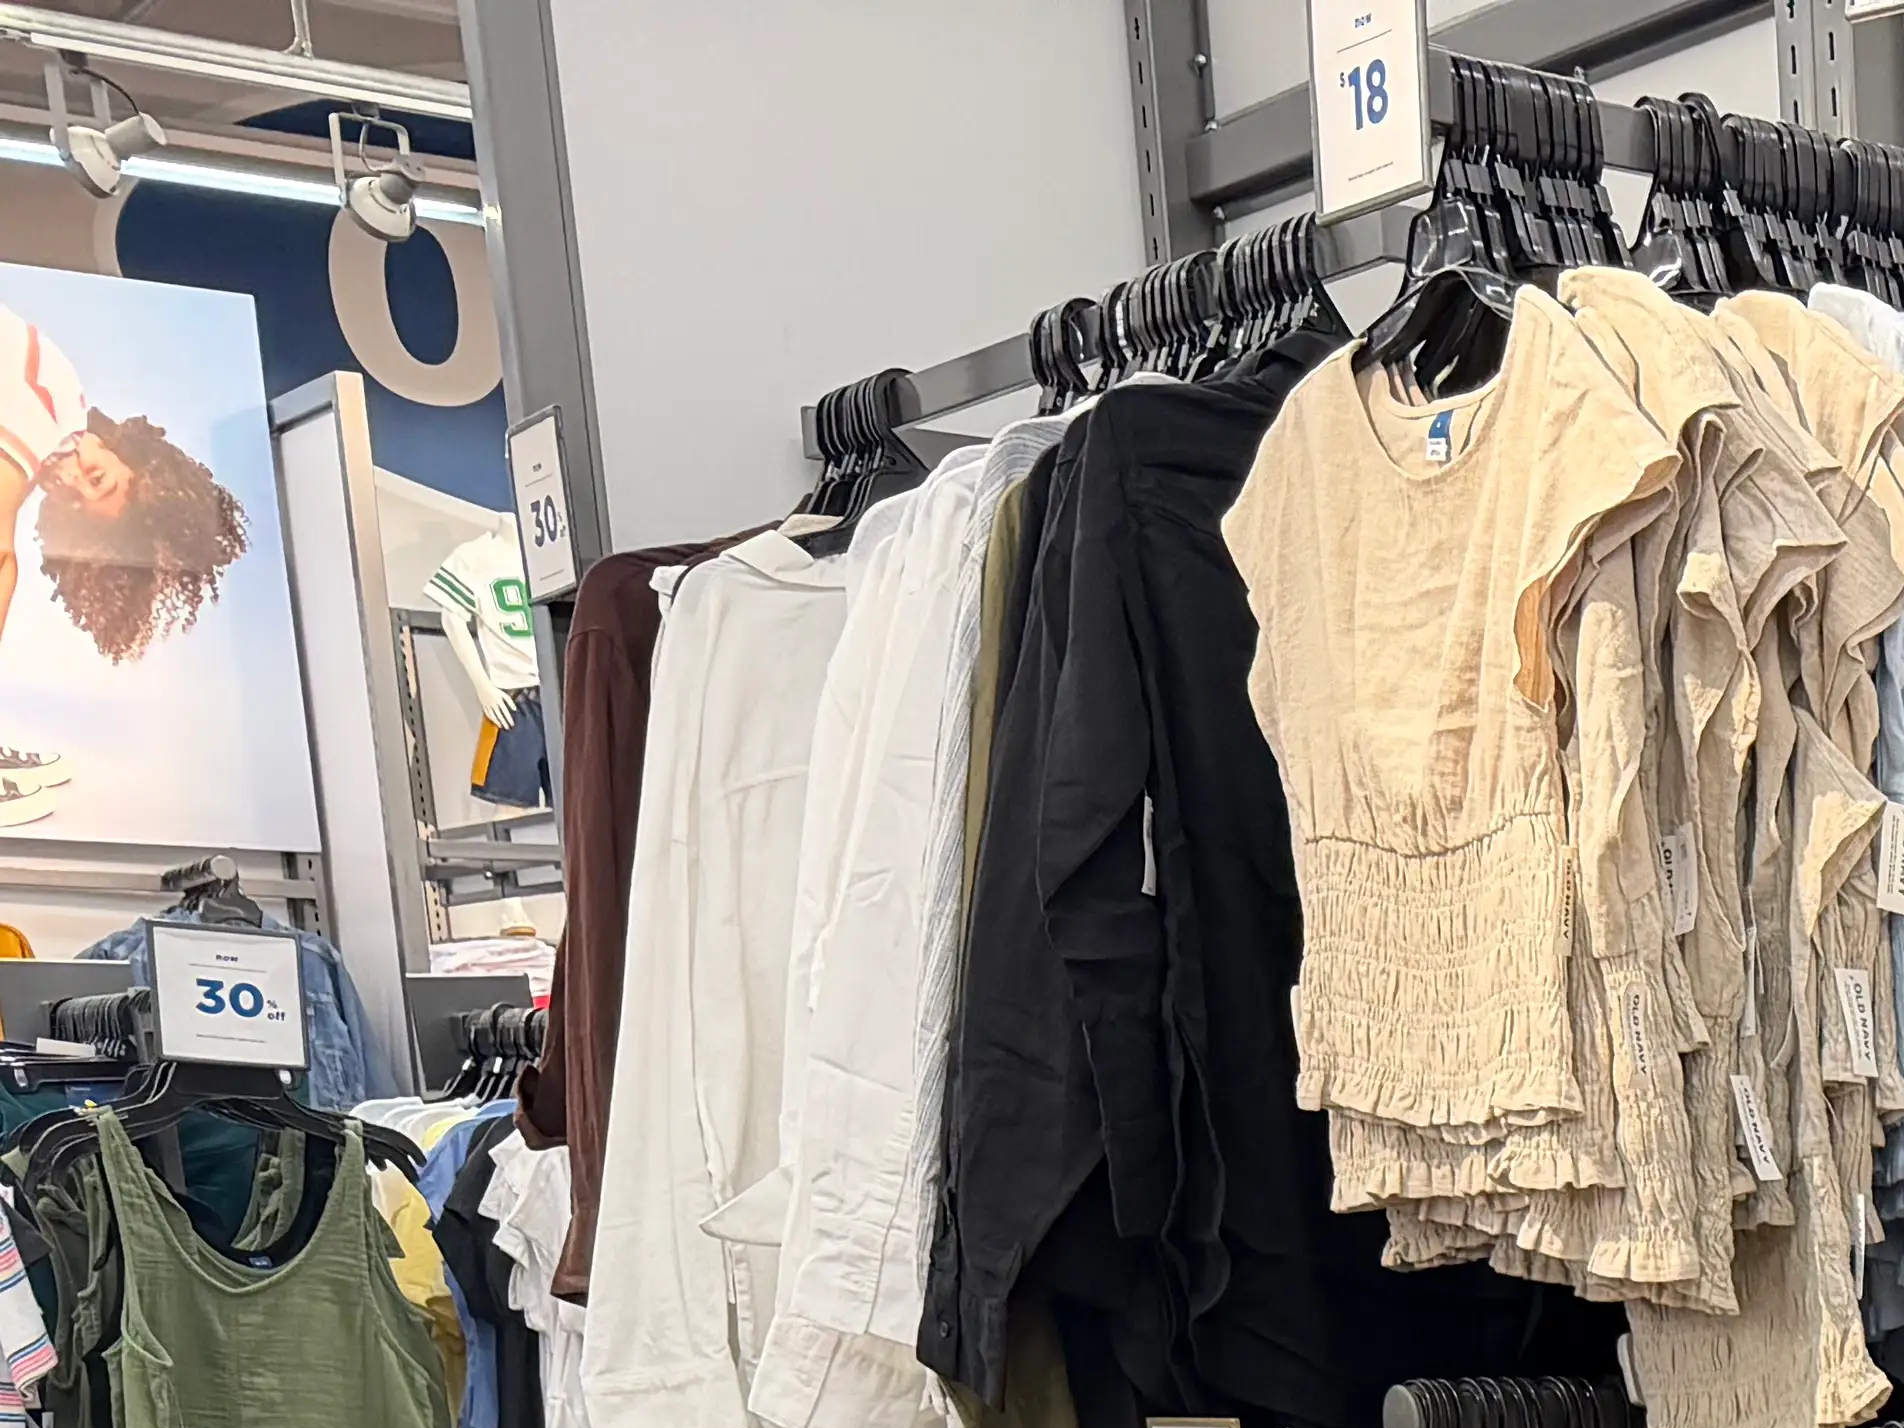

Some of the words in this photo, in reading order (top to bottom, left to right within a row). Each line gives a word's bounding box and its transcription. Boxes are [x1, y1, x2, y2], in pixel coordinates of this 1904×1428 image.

[1562, 893, 1573, 939] NAVY
[267, 1011, 286, 1021] off
[1632, 993, 1641, 1026] OLD
[1853, 983, 1865, 1015] OLD
[1860, 1018, 1872, 1061] NAVY
[1634, 1030, 1647, 1074] NAVY
[1744, 1087, 1756, 1117] OLD
[1752, 1120, 1770, 1165] NAVY
